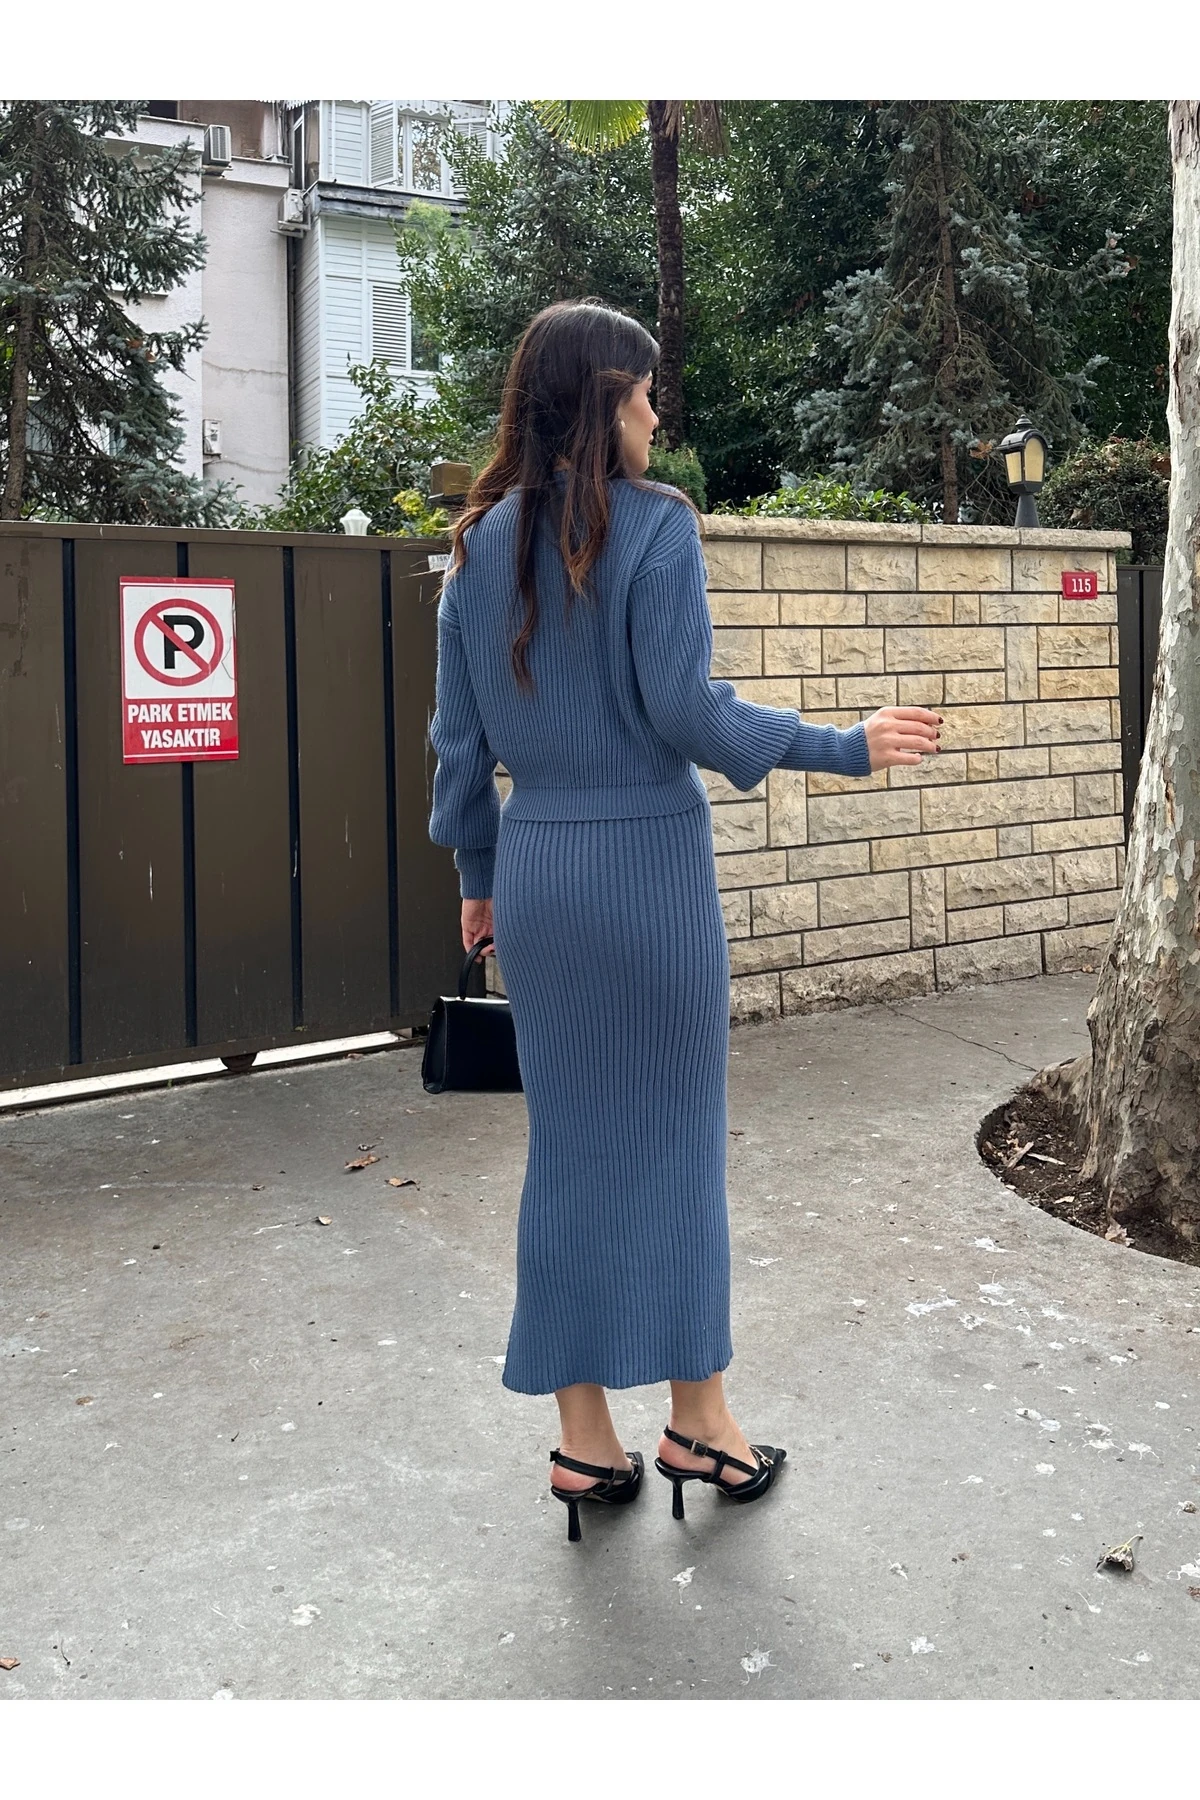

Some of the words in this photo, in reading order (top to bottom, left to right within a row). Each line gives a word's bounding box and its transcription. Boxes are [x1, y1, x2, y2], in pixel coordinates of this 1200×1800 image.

[1071, 578, 1092, 593] 115
[163, 614, 205, 669] P
[128, 703, 173, 724] PARK
[177, 702, 233, 723] ETMEK
[140, 728, 221, 749] YASAKTIR
